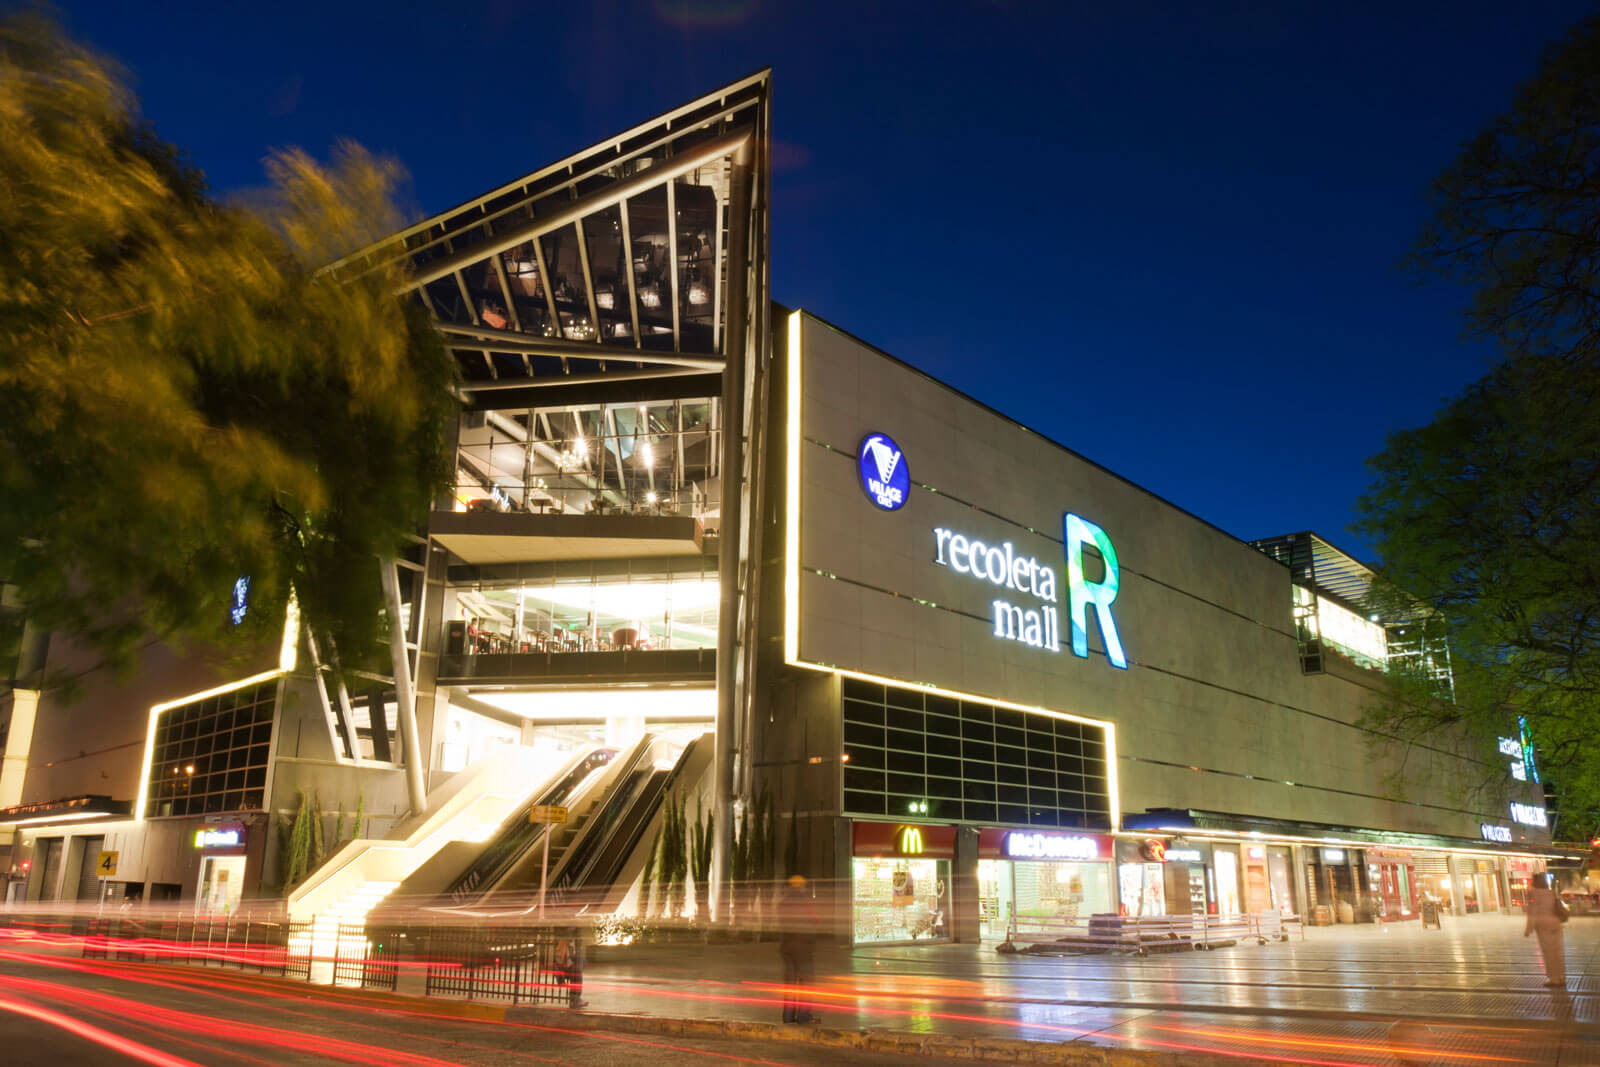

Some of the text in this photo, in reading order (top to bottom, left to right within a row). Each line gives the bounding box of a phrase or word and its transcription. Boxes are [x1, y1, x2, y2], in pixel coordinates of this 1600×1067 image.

[868, 478, 902, 504] VILLAGE
[933, 527, 1057, 602] recoleta
[1064, 511, 1128, 670] R
[993, 600, 1060, 652] mall
[102, 855, 112, 871] 4
